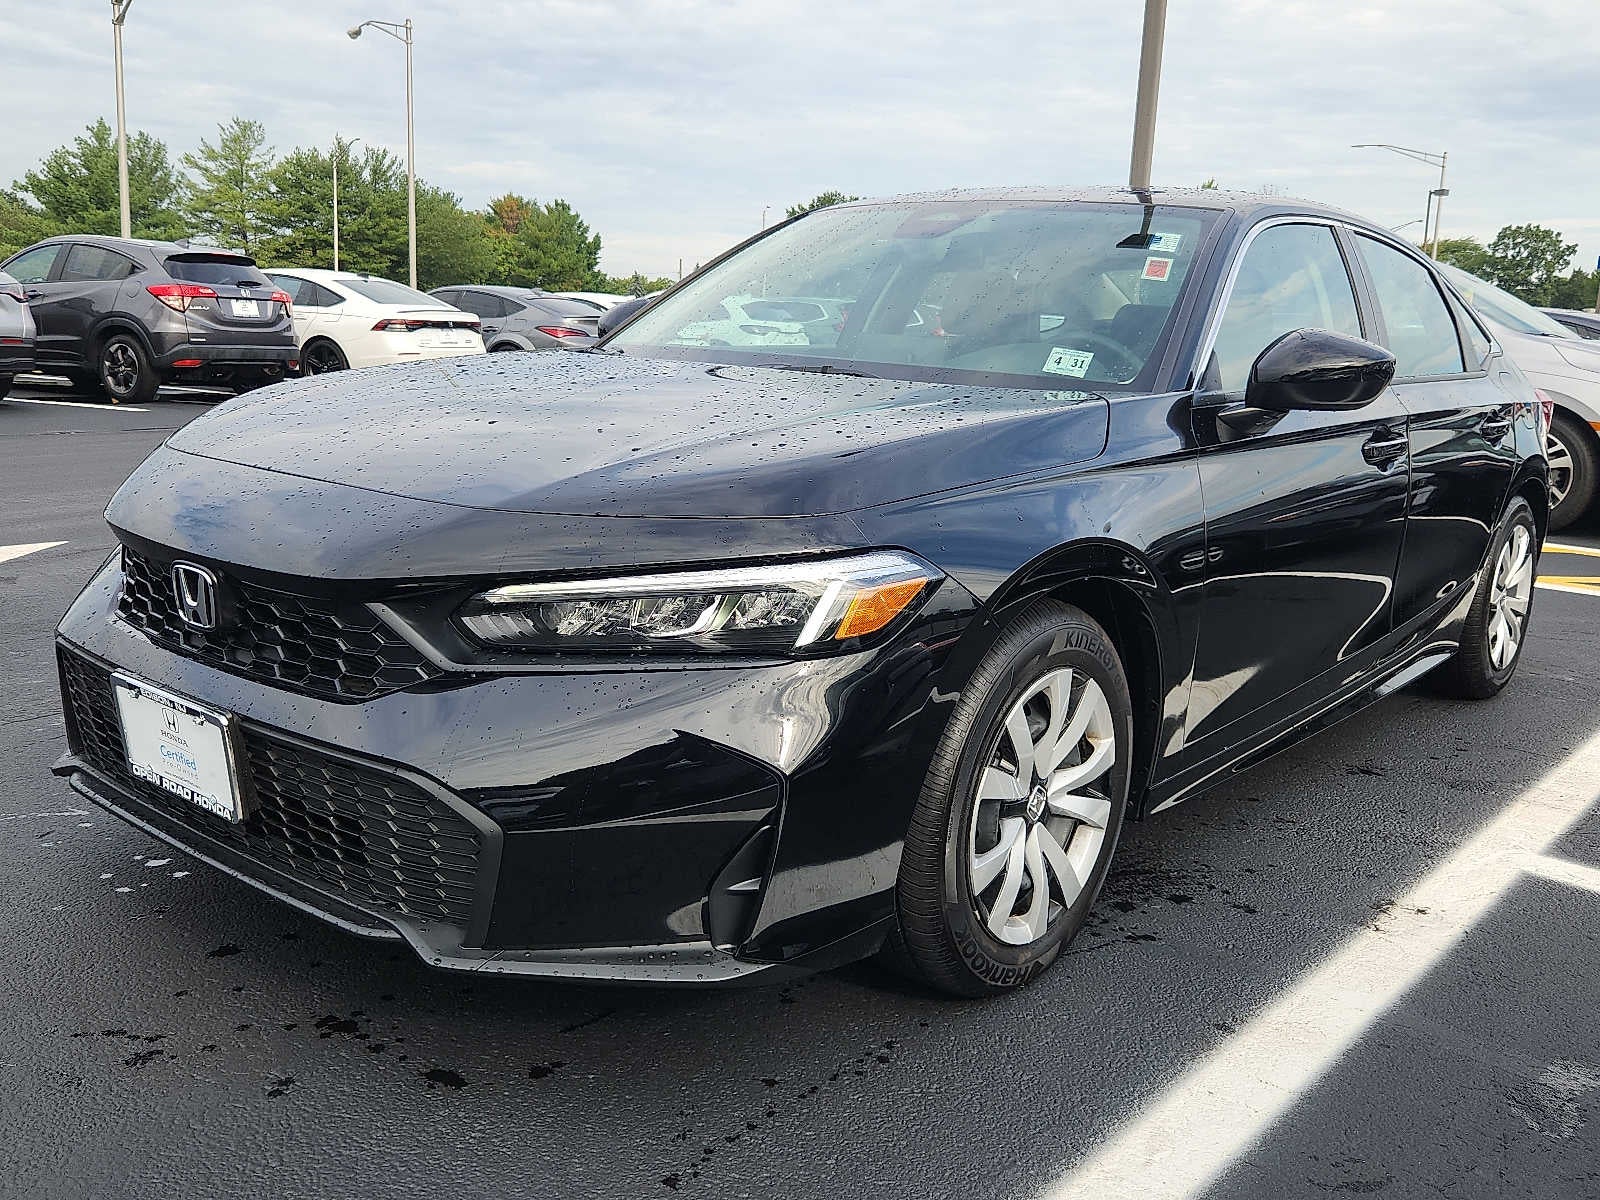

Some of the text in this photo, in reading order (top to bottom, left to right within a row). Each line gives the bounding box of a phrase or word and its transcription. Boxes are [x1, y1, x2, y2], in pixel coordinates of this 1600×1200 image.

[1054, 356, 1085, 369] 4 31
[160, 729, 189, 747] HONDA
[160, 744, 197, 771] Certified
[132, 763, 160, 785] OPEN
[162, 777, 192, 800] ROAD
[193, 792, 232, 821] HONDA
